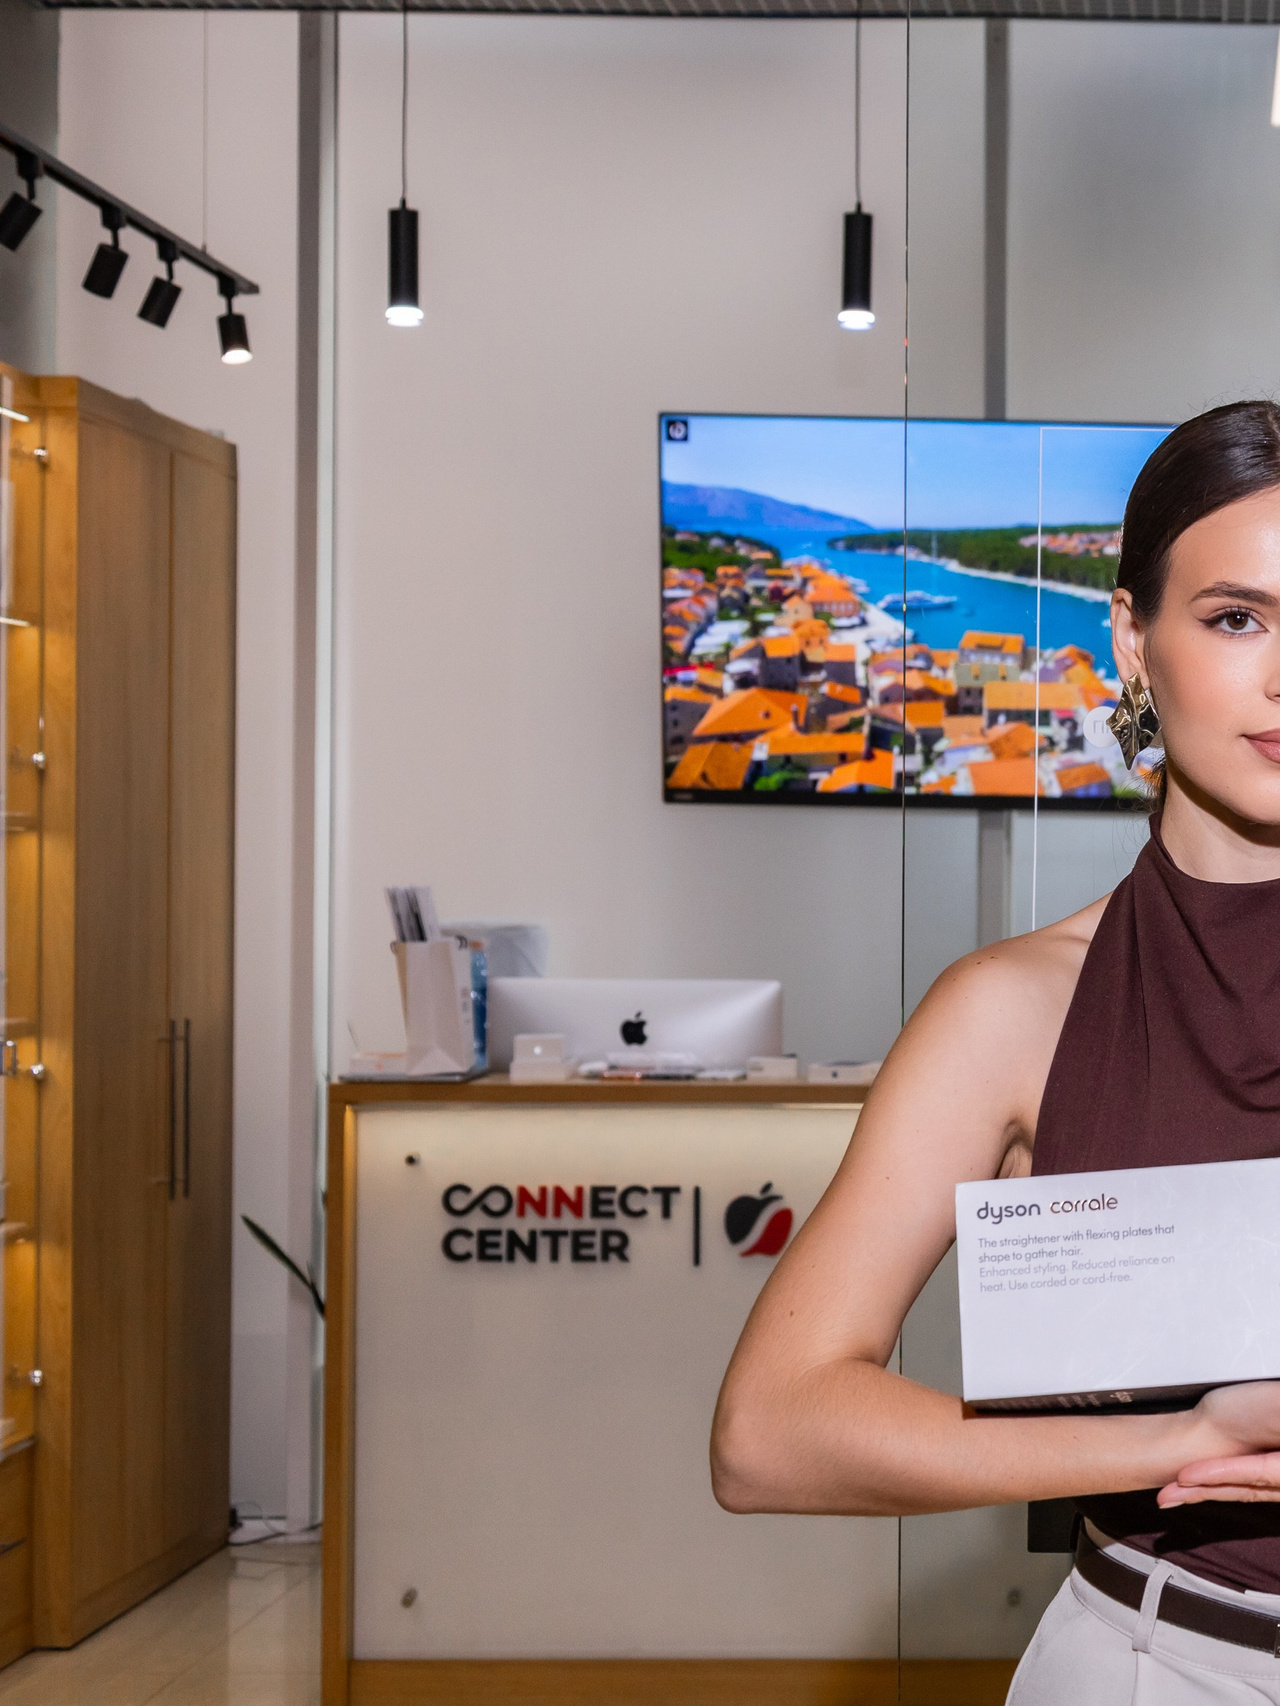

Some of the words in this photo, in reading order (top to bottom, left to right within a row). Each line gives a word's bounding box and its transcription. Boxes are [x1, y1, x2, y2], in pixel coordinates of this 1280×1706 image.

[441, 1183, 681, 1220] CONNECT
[976, 1201, 1041, 1225] dyson
[1049, 1193, 1118, 1214] corrale
[441, 1228, 630, 1263] CENTER
[978, 1237, 998, 1248] The
[1000, 1233, 1060, 1248] straightener
[1062, 1230, 1084, 1242] with
[1086, 1228, 1120, 1241] flexing
[1122, 1226, 1153, 1239] plates
[1154, 1224, 1175, 1235] that
[979, 1252, 1011, 1265] shape
[1012, 1251, 1023, 1260] to
[1024, 1247, 1059, 1262] gather
[1060, 1245, 1084, 1257] hair.
[980, 1264, 1031, 1278] Enhanced
[1033, 1261, 1069, 1275] styling.
[1071, 1257, 1116, 1271] Reduced
[1118, 1255, 1159, 1267] reliance
[1160, 1255, 1175, 1264] on
[980, 1281, 1006, 1293] heat.
[1008, 1279, 1028, 1290] Use
[1030, 1275, 1067, 1288] corded
[1068, 1277, 1080, 1286] or
[1082, 1271, 1133, 1285] cord-free.
